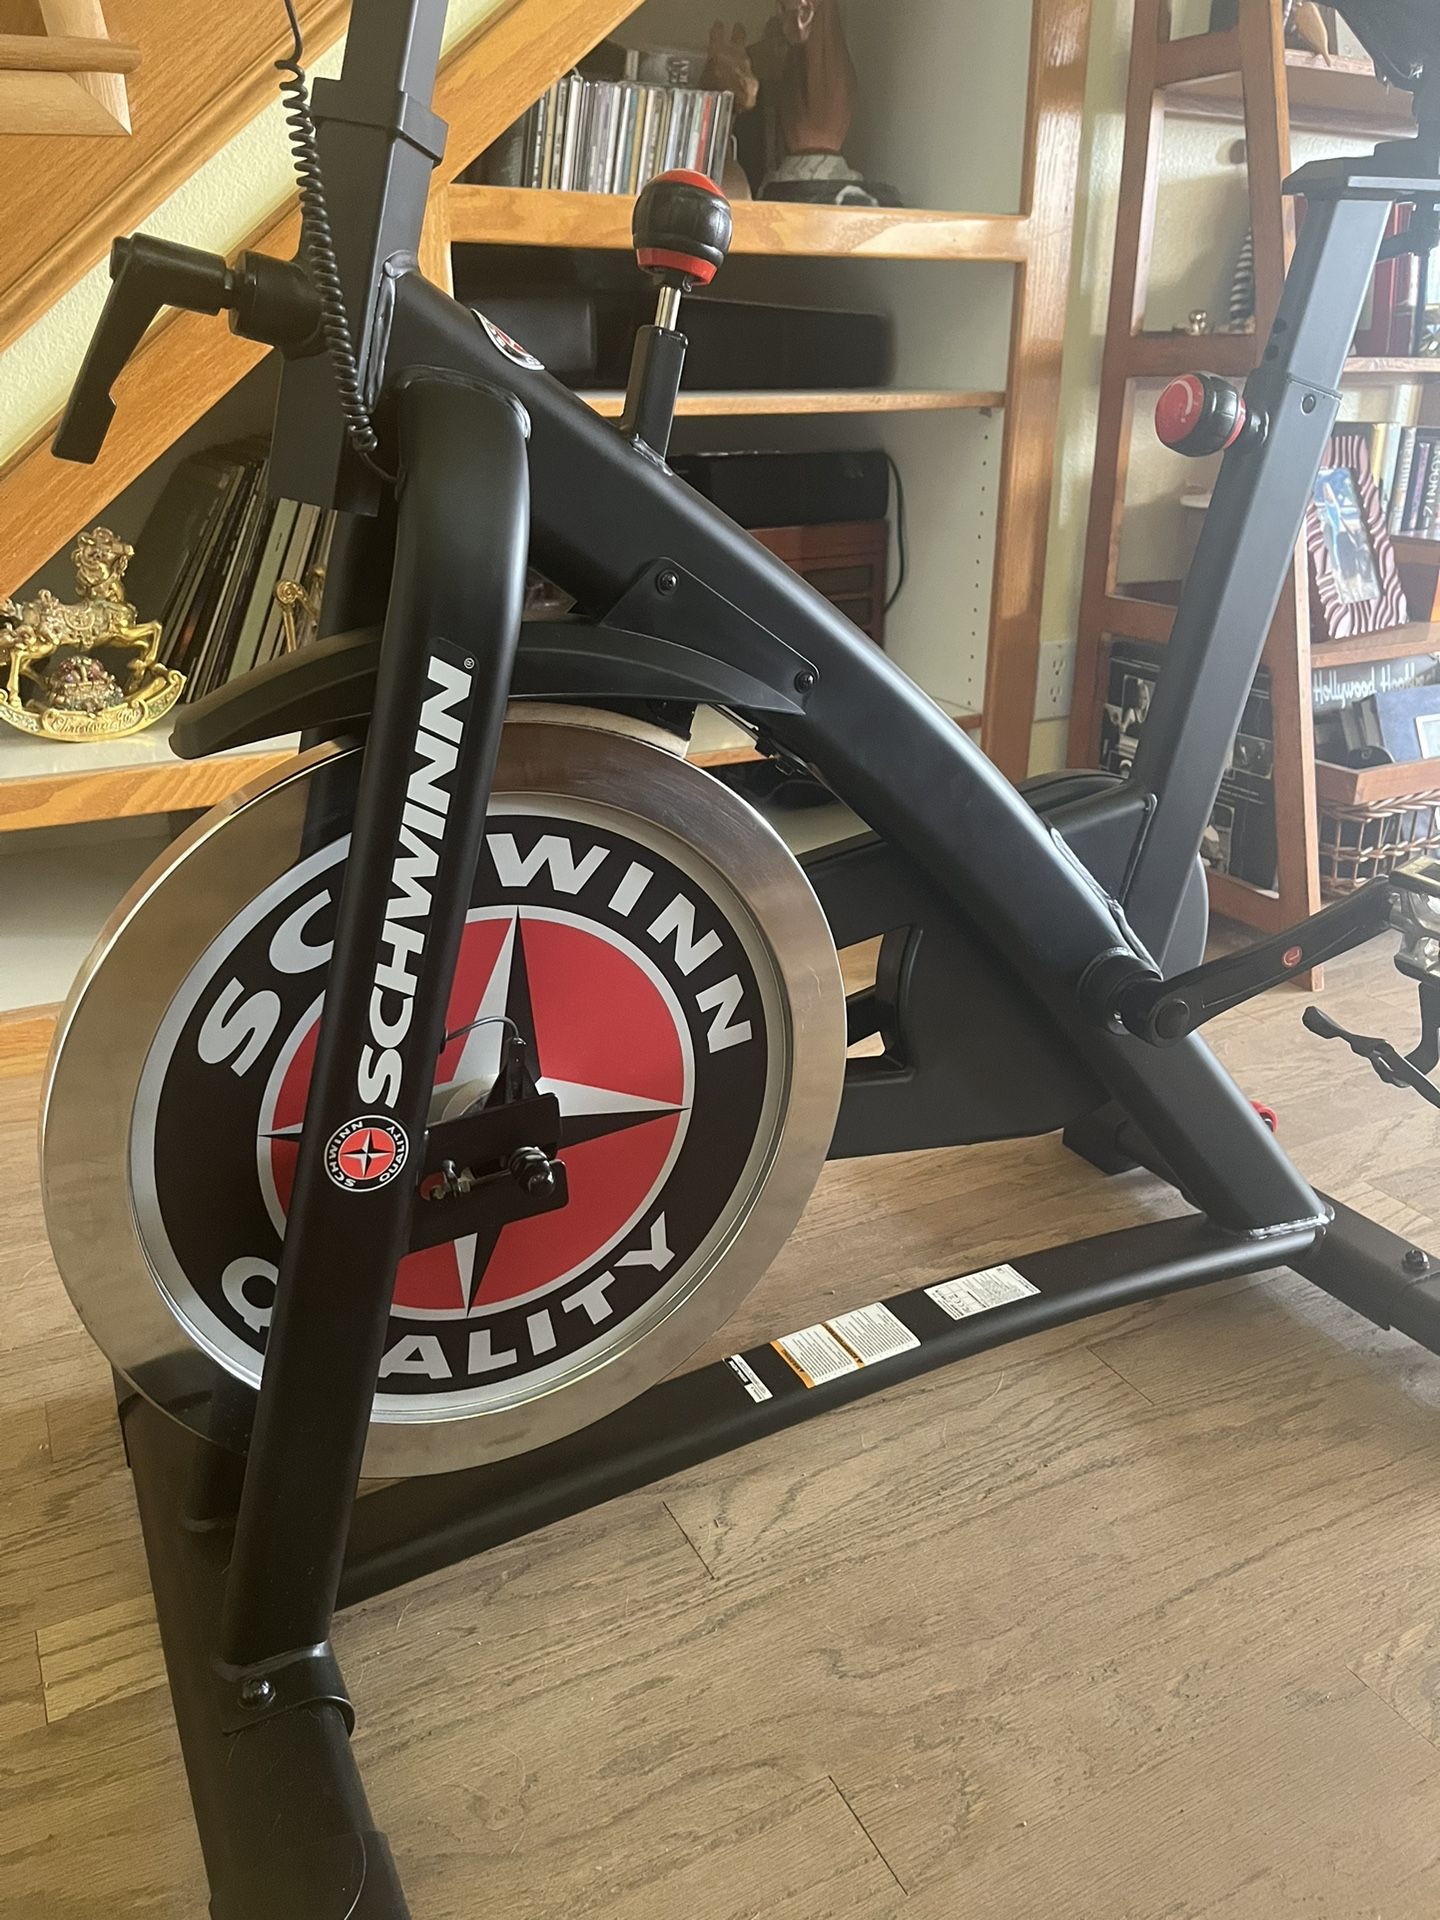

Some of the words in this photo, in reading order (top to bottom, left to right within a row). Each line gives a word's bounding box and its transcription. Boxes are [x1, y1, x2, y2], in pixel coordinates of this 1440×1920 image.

[1313, 666, 1377, 709] Hollywood
[358, 656, 472, 1108] SCHWINN
[197, 833, 754, 1077] SCWINN
[328, 1120, 364, 1187] SCHWINN
[379, 1125, 405, 1182] QUALITY
[221, 1210, 677, 1380] QALITY
